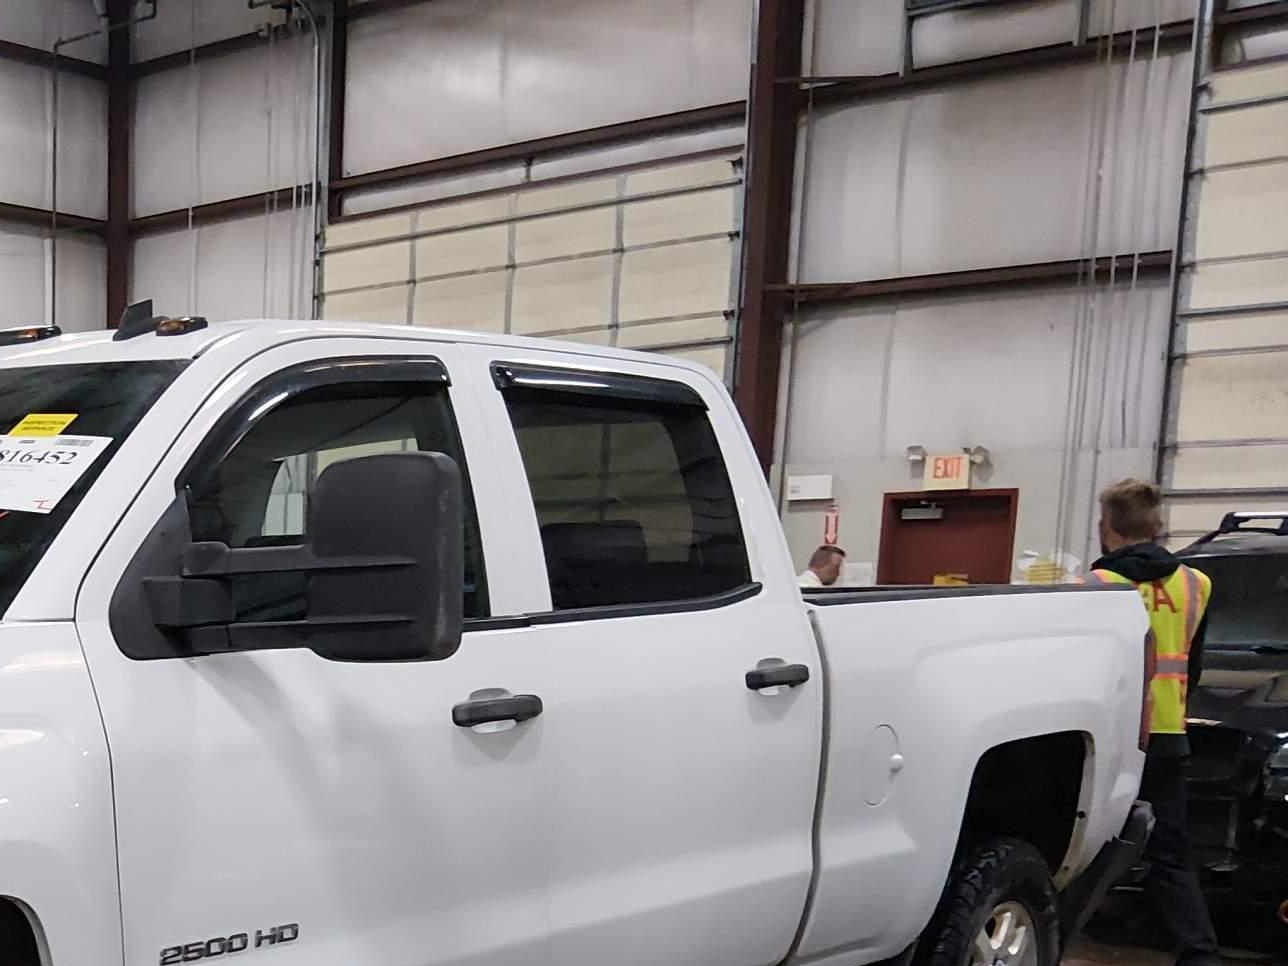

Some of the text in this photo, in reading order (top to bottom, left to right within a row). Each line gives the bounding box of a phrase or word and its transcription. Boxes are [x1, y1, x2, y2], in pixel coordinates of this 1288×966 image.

[933, 456, 962, 479] EXIT
[159, 923, 300, 966] 2500 HD
